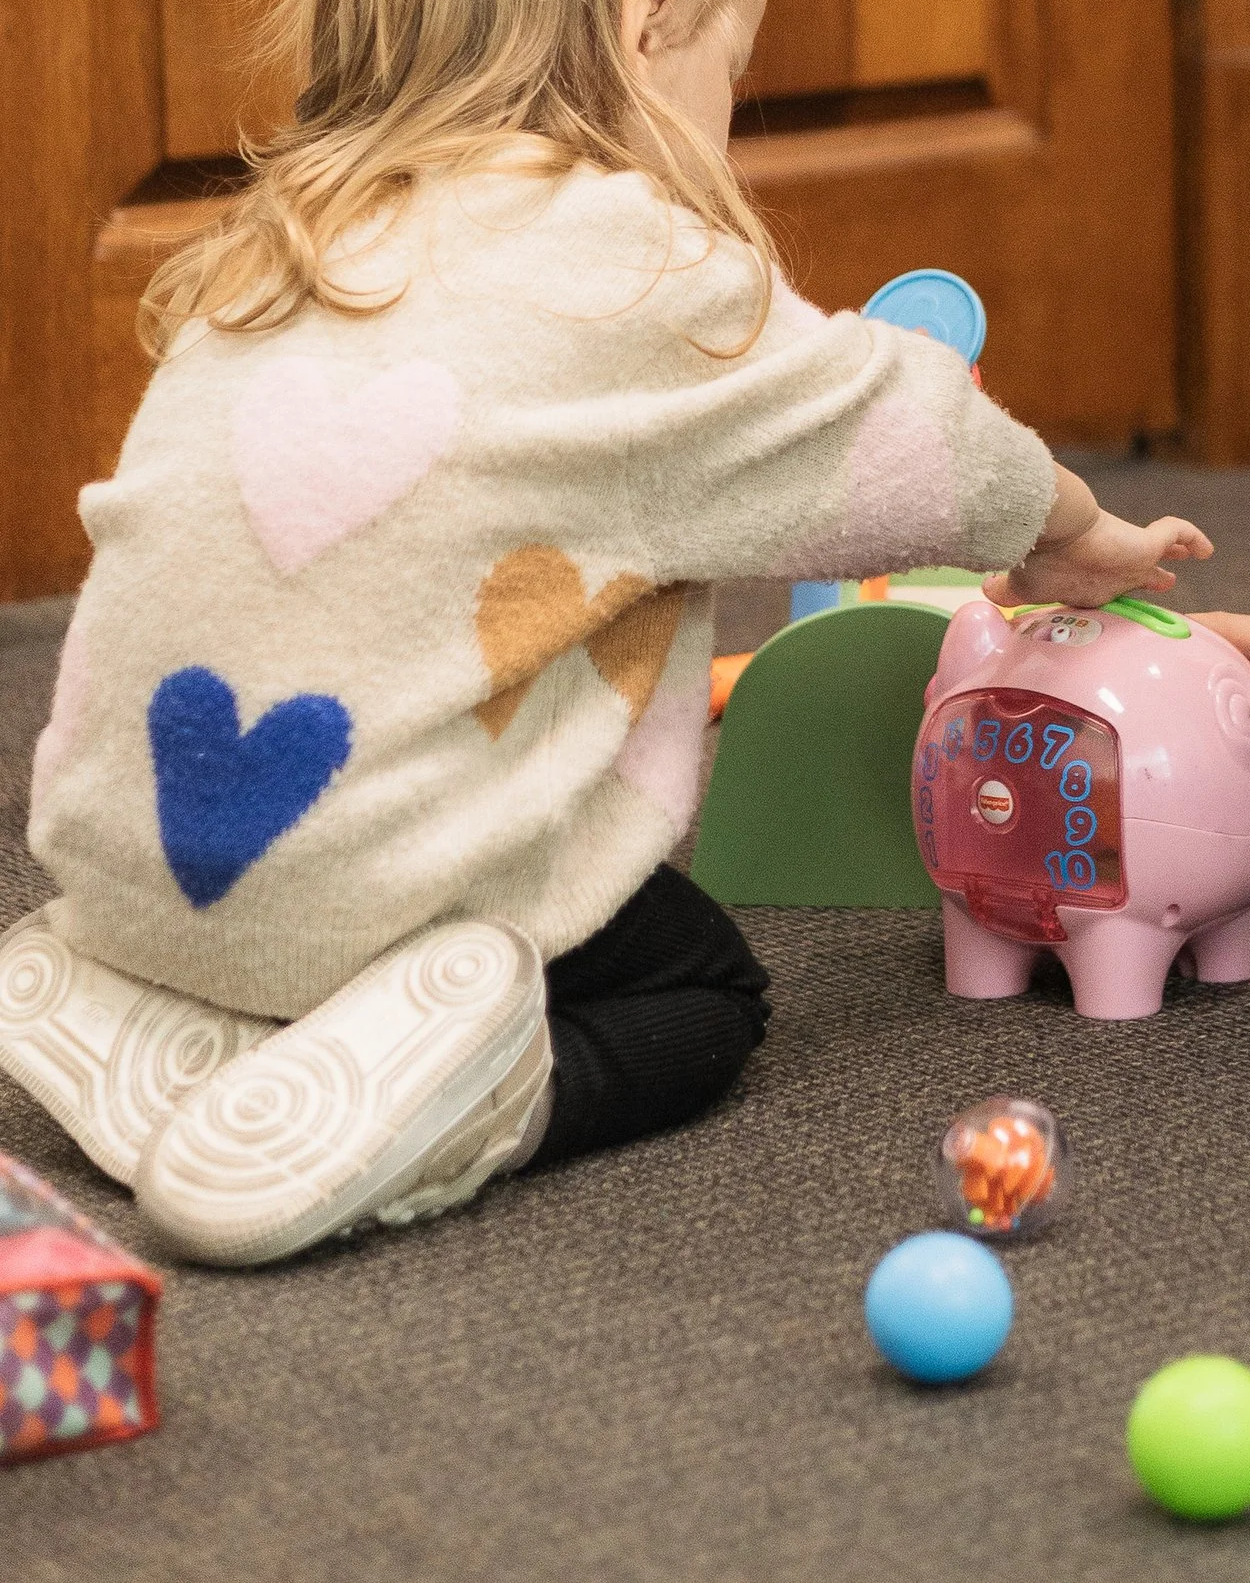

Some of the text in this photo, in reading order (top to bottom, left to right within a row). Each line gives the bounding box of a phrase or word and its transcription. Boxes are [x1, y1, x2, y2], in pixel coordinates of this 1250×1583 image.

[973, 720, 1001, 761] 5
[1004, 722, 1034, 764] 6
[1040, 724, 1076, 770] 7
[1059, 759, 1092, 803] 8
[1064, 805, 1097, 847] 9
[1044, 849, 1096, 890] 10
